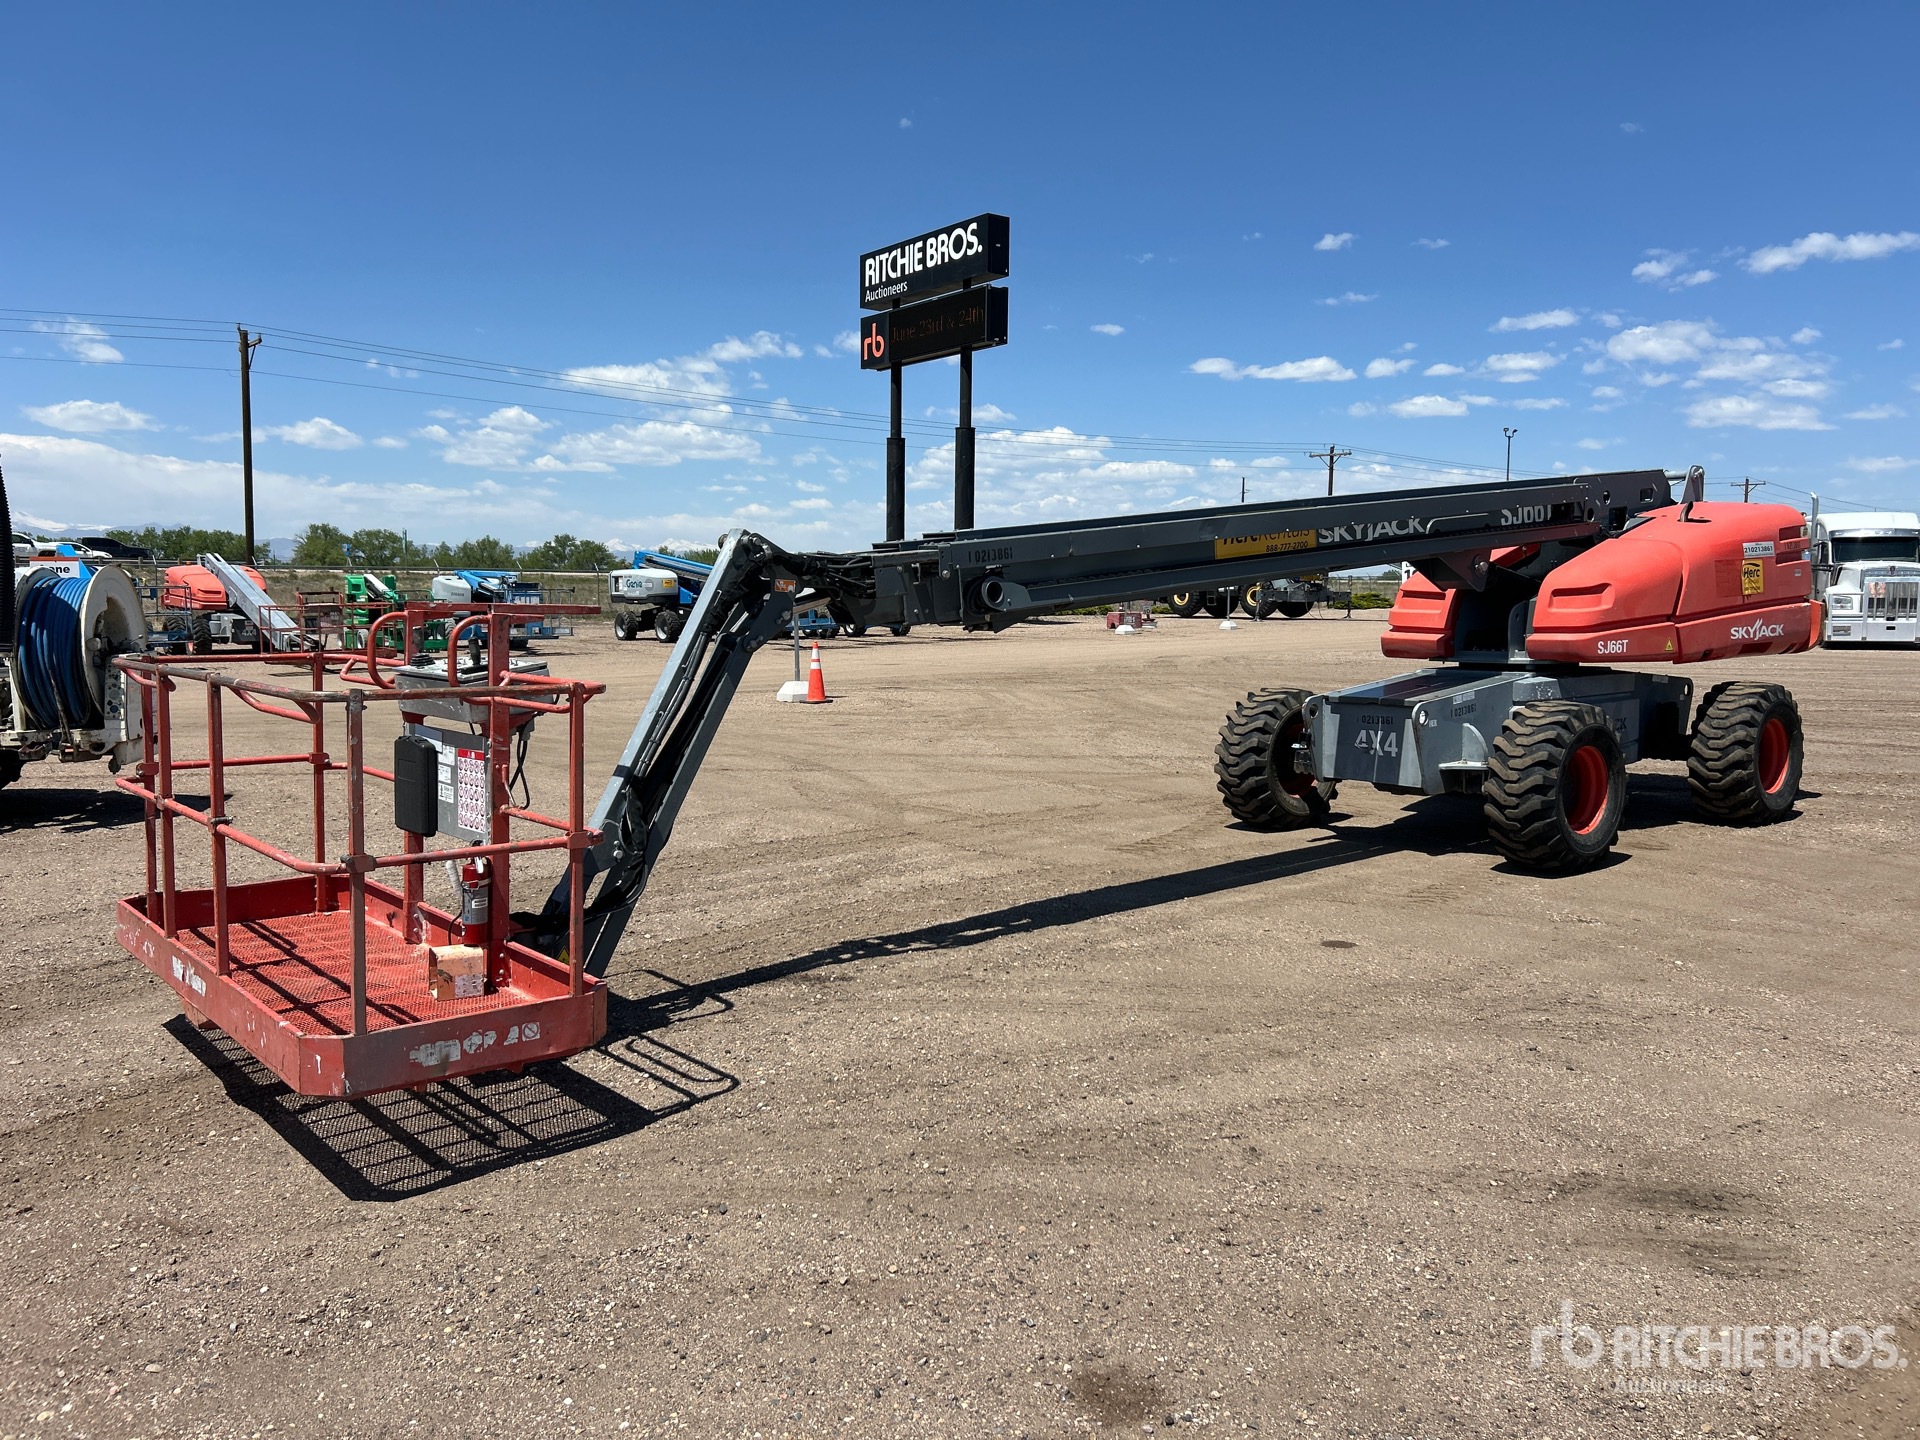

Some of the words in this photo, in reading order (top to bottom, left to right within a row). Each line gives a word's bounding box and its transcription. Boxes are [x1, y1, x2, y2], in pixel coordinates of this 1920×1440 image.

[865, 240, 923, 287] RITCHIE
[926, 222, 983, 268] BROS.
[865, 281, 908, 303] Auctioneers
[863, 322, 885, 361] rb
[1318, 518, 1425, 544] SKYJACK
[1743, 567, 1761, 579] Herc
[1730, 618, 1784, 641] SKYJACK
[1597, 639, 1629, 654] SJ66T
[1354, 729, 1399, 757] 4X4
